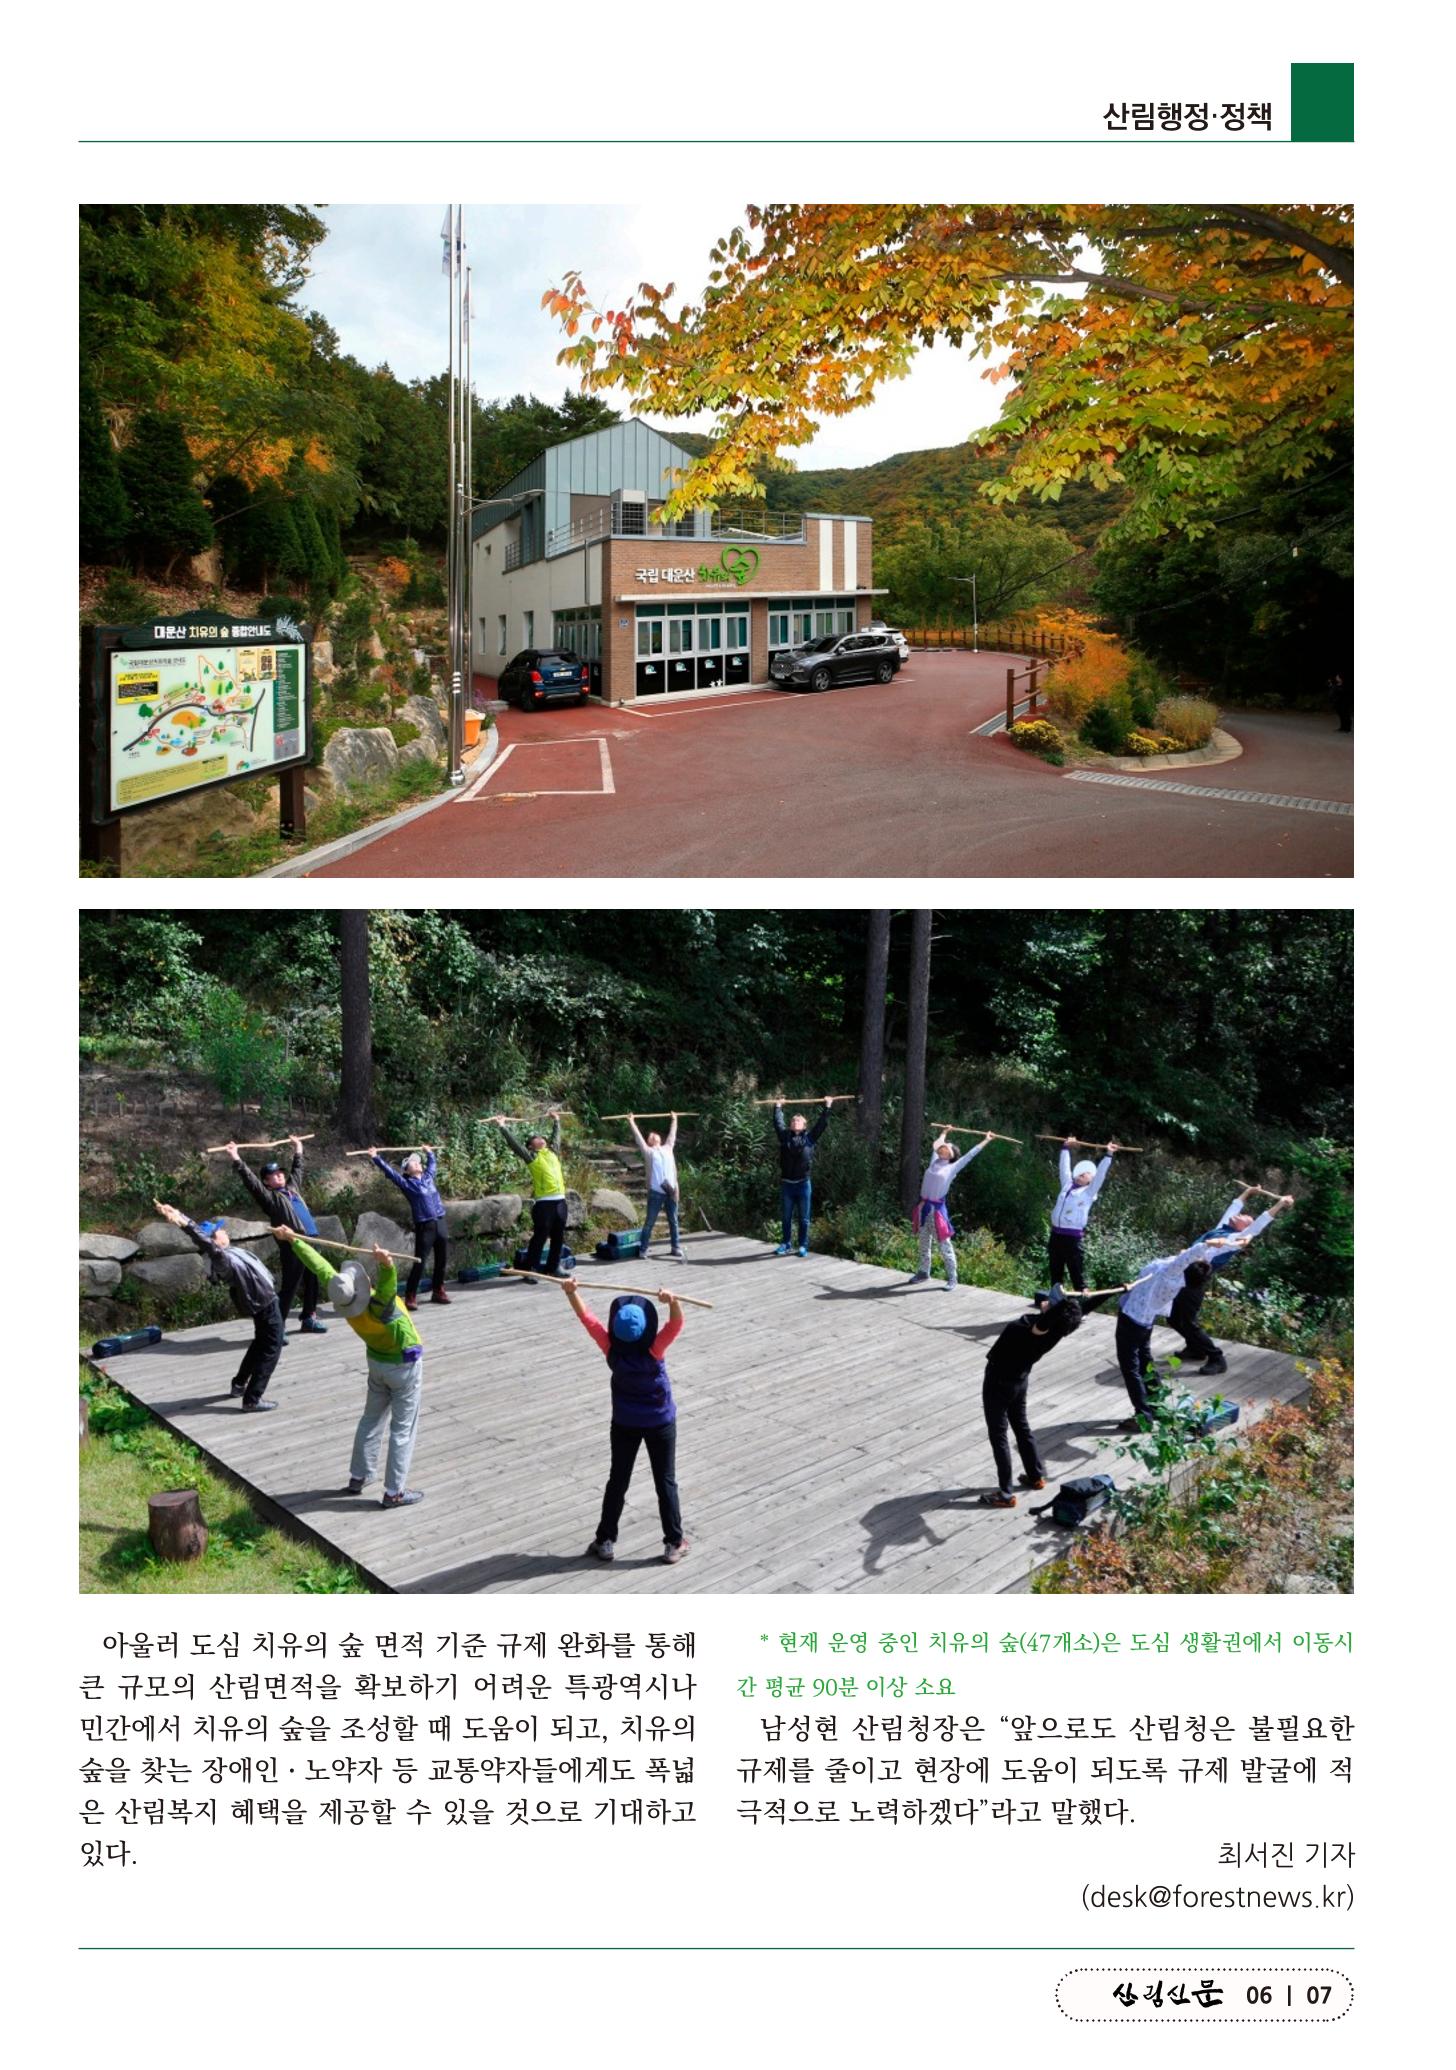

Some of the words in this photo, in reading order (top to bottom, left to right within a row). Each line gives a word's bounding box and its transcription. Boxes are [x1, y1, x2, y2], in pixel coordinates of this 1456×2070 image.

[1103, 102, 1272, 131] 산림행정·정책
[635, 568, 658, 584] 국립
[661, 567, 695, 584] 대운산
[189, 626, 218, 638] 치유의
[220, 626, 230, 638] 숲
[104, 1632, 177, 1659] 아울러
[190, 1632, 238, 1659] 도심
[253, 1632, 326, 1659] 치유의
[339, 1632, 364, 1659] 숲
[376, 1632, 422, 1659] 면적
[437, 1632, 487, 1659] 기준
[497, 1632, 545, 1659] 규제
[558, 1632, 635, 1659] 완화를
[645, 1632, 694, 1659] 통해
[779, 1632, 817, 1654] 현재
[829, 1632, 866, 1654] 운영
[879, 1632, 917, 1654] 중인
[930, 1632, 988, 1654] 치유의
[1000, 1632, 1120, 1654] 숲(47개소)은
[1131, 1632, 1168, 1654] 도심
[1180, 1632, 1280, 1654] 생활권에서
[1294, 1632, 1351, 1654] 이동시
[79, 1674, 104, 1700] 큰
[118, 1674, 193, 1700] 규모의
[210, 1674, 341, 1700] 산림면적을
[355, 1674, 456, 1700] 확보하기
[475, 1674, 551, 1700] 어려운
[565, 1674, 697, 1700] 특광역시나
[737, 1676, 756, 1698] 간
[767, 1676, 805, 1698] 평균
[813, 1676, 858, 1698] 90분
[867, 1676, 907, 1698] 이상
[915, 1676, 955, 1698] 소요
[81, 1715, 179, 1742] 민간에서
[194, 1715, 267, 1742] 치유의
[280, 1715, 331, 1742] 숲을
[341, 1715, 418, 1742] 조성할
[429, 1715, 450, 1742] 때
[463, 1715, 536, 1742] 도움이
[551, 1715, 607, 1742] 되고,
[621, 1715, 694, 1742] 치유의
[761, 1715, 838, 1742] 남성현
[853, 1715, 985, 1742] 산림청장은
[1001, 1715, 1116, 1742] “앞으로도
[1130, 1715, 1235, 1742] 산림청은
[1249, 1715, 1355, 1742] 불필요한
[79, 1757, 130, 1784] 숲을
[141, 1757, 192, 1784] 찾는
[202, 1757, 278, 1784] 장애인
[305, 1757, 382, 1784] 노약자
[393, 1757, 418, 1784] 등
[428, 1757, 635, 1784] 교통약자들에게도
[645, 1757, 693, 1784] 폭넓
[737, 1757, 814, 1784] 규제를
[825, 1757, 902, 1784] 줄이고
[915, 1757, 988, 1784] 현장에
[1002, 1757, 1075, 1784] 도움이
[1091, 1757, 1167, 1784] 되도록
[1179, 1757, 1227, 1784] 규제
[1241, 1757, 1315, 1784] 발굴에
[1330, 1757, 1351, 1784] 적
[79, 1799, 104, 1825] 은
[115, 1799, 215, 1825] 산림복지
[231, 1799, 307, 1825] 혜택을
[319, 1799, 396, 1825] 제공할
[407, 1799, 432, 1825] 수
[445, 1799, 494, 1825] 있을
[506, 1799, 582, 1825] 것으로
[595, 1799, 696, 1825] 기대하고
[737, 1799, 840, 1825] 극적으로
[850, 1799, 1041, 1825] 노력하겠다”라고
[1052, 1799, 1134, 1825] 말했다.
[81, 1840, 137, 1867] 있다.
[1218, 1842, 1293, 1868] 최서진
[1306, 1842, 1355, 1868] 기자
[1082, 1884, 1353, 1911] (desk@forestnews.kr)
[1113, 1980, 1224, 2008] 산림신문
[1247, 1986, 1272, 2004] 06
[1307, 1986, 1332, 2004] 07
